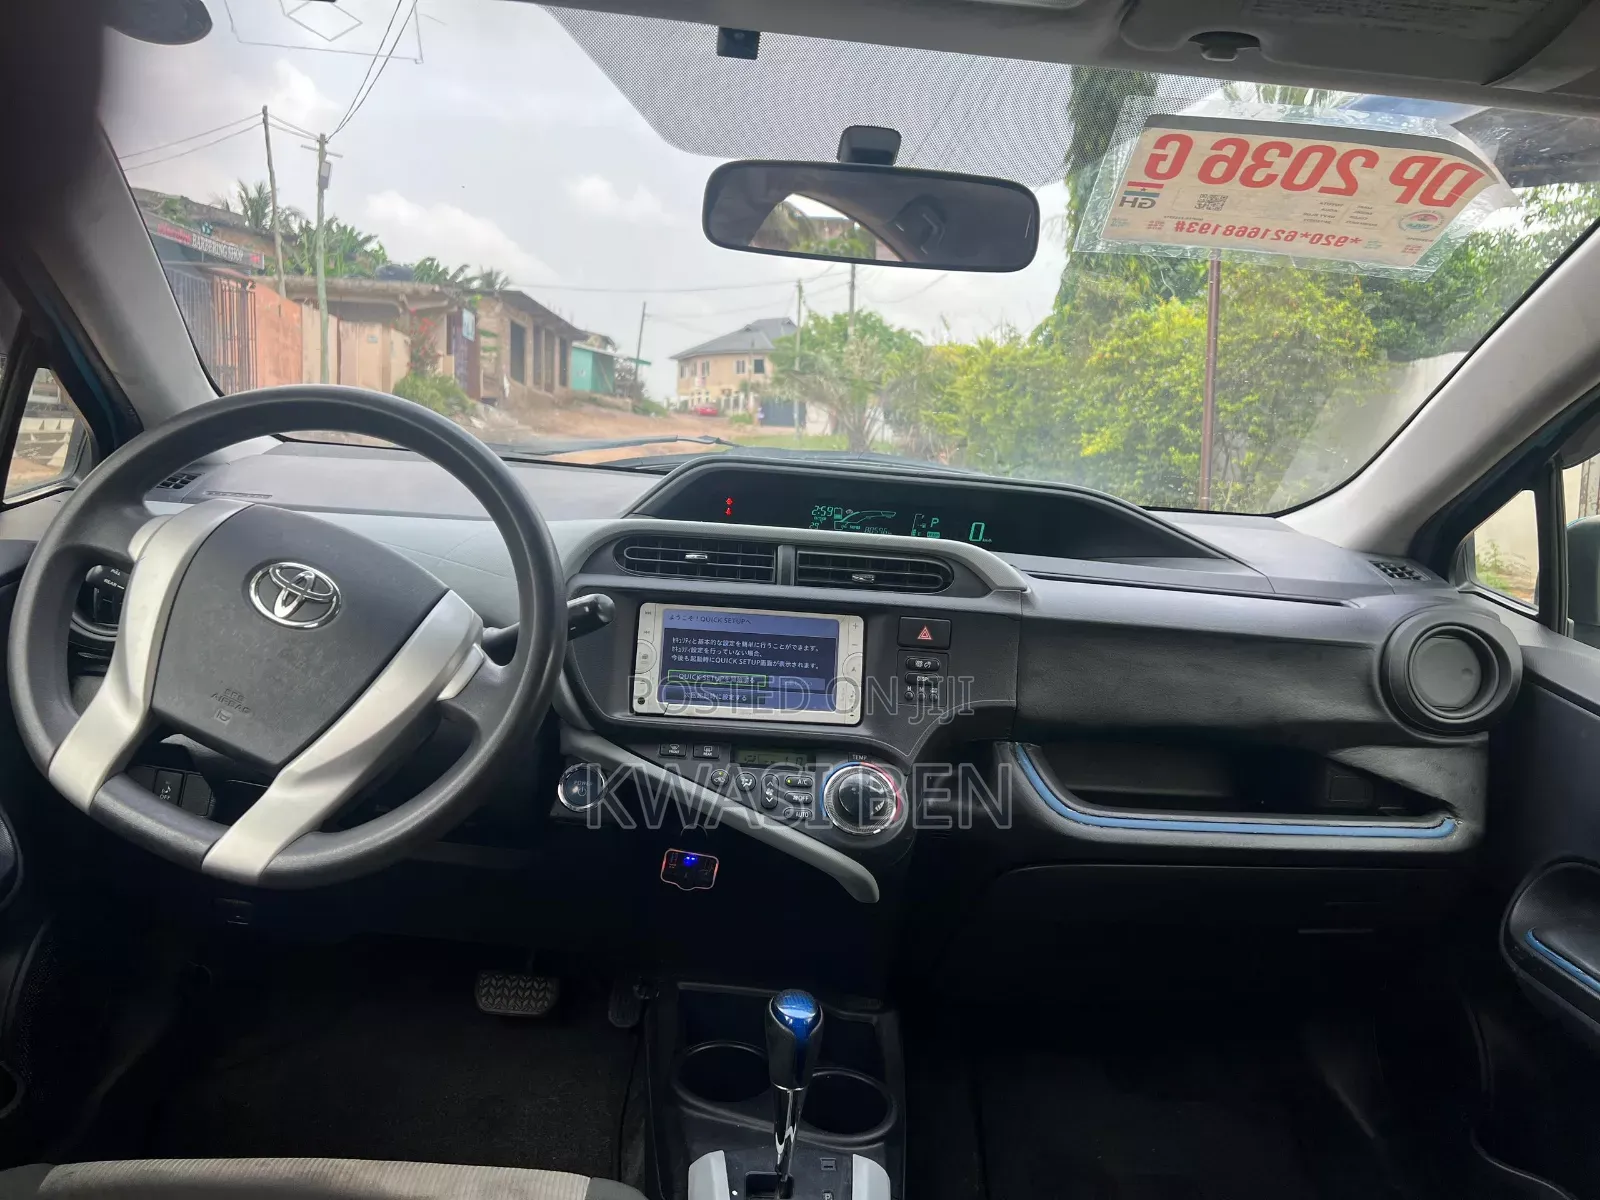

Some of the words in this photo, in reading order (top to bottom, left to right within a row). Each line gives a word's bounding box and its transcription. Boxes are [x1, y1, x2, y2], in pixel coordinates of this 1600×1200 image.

[811, 505, 834, 516] 2:59
[930, 518, 939, 528] P
[969, 522, 986, 541] 0
